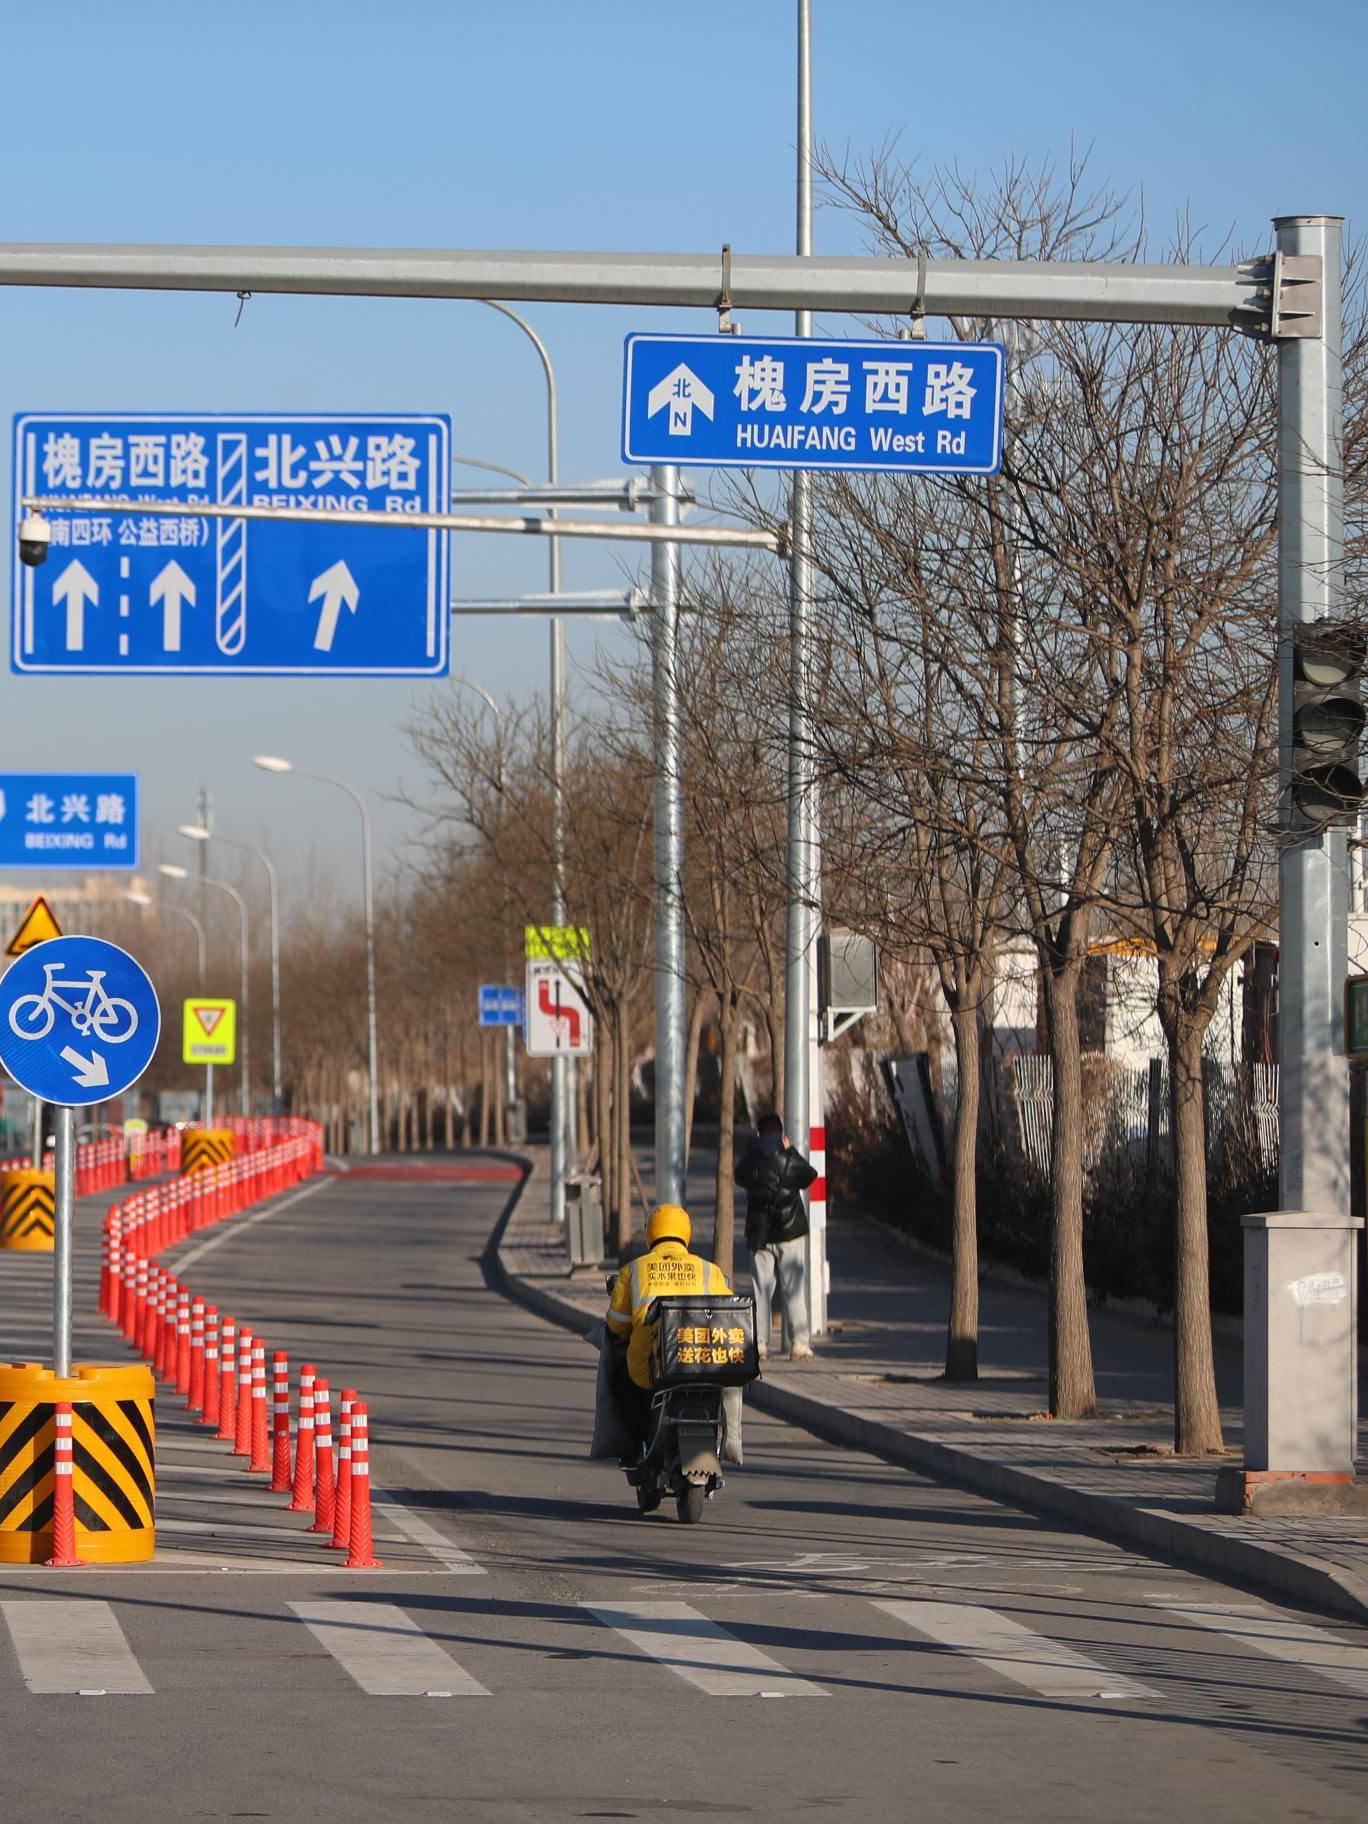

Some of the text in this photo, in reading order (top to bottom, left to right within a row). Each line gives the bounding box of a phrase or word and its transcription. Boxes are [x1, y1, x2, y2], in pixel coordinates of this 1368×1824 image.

[672, 377, 692, 398] 北
[733, 354, 978, 420] 槐房西路
[673, 410, 687, 428] N
[736, 423, 966, 455] HUAIFANG West Rd
[43, 432, 209, 490] 槐房西路
[254, 433, 421, 491] 北兴路
[252, 494, 421, 513] BEIXING Rd
[26, 793, 125, 823] 北兴路
[25, 832, 127, 849] BEIXING Rd
[646, 1262, 695, 1272] 美团外卖
[677, 1327, 745, 1344] 美团外卖
[677, 1346, 745, 1364] 送花也快
